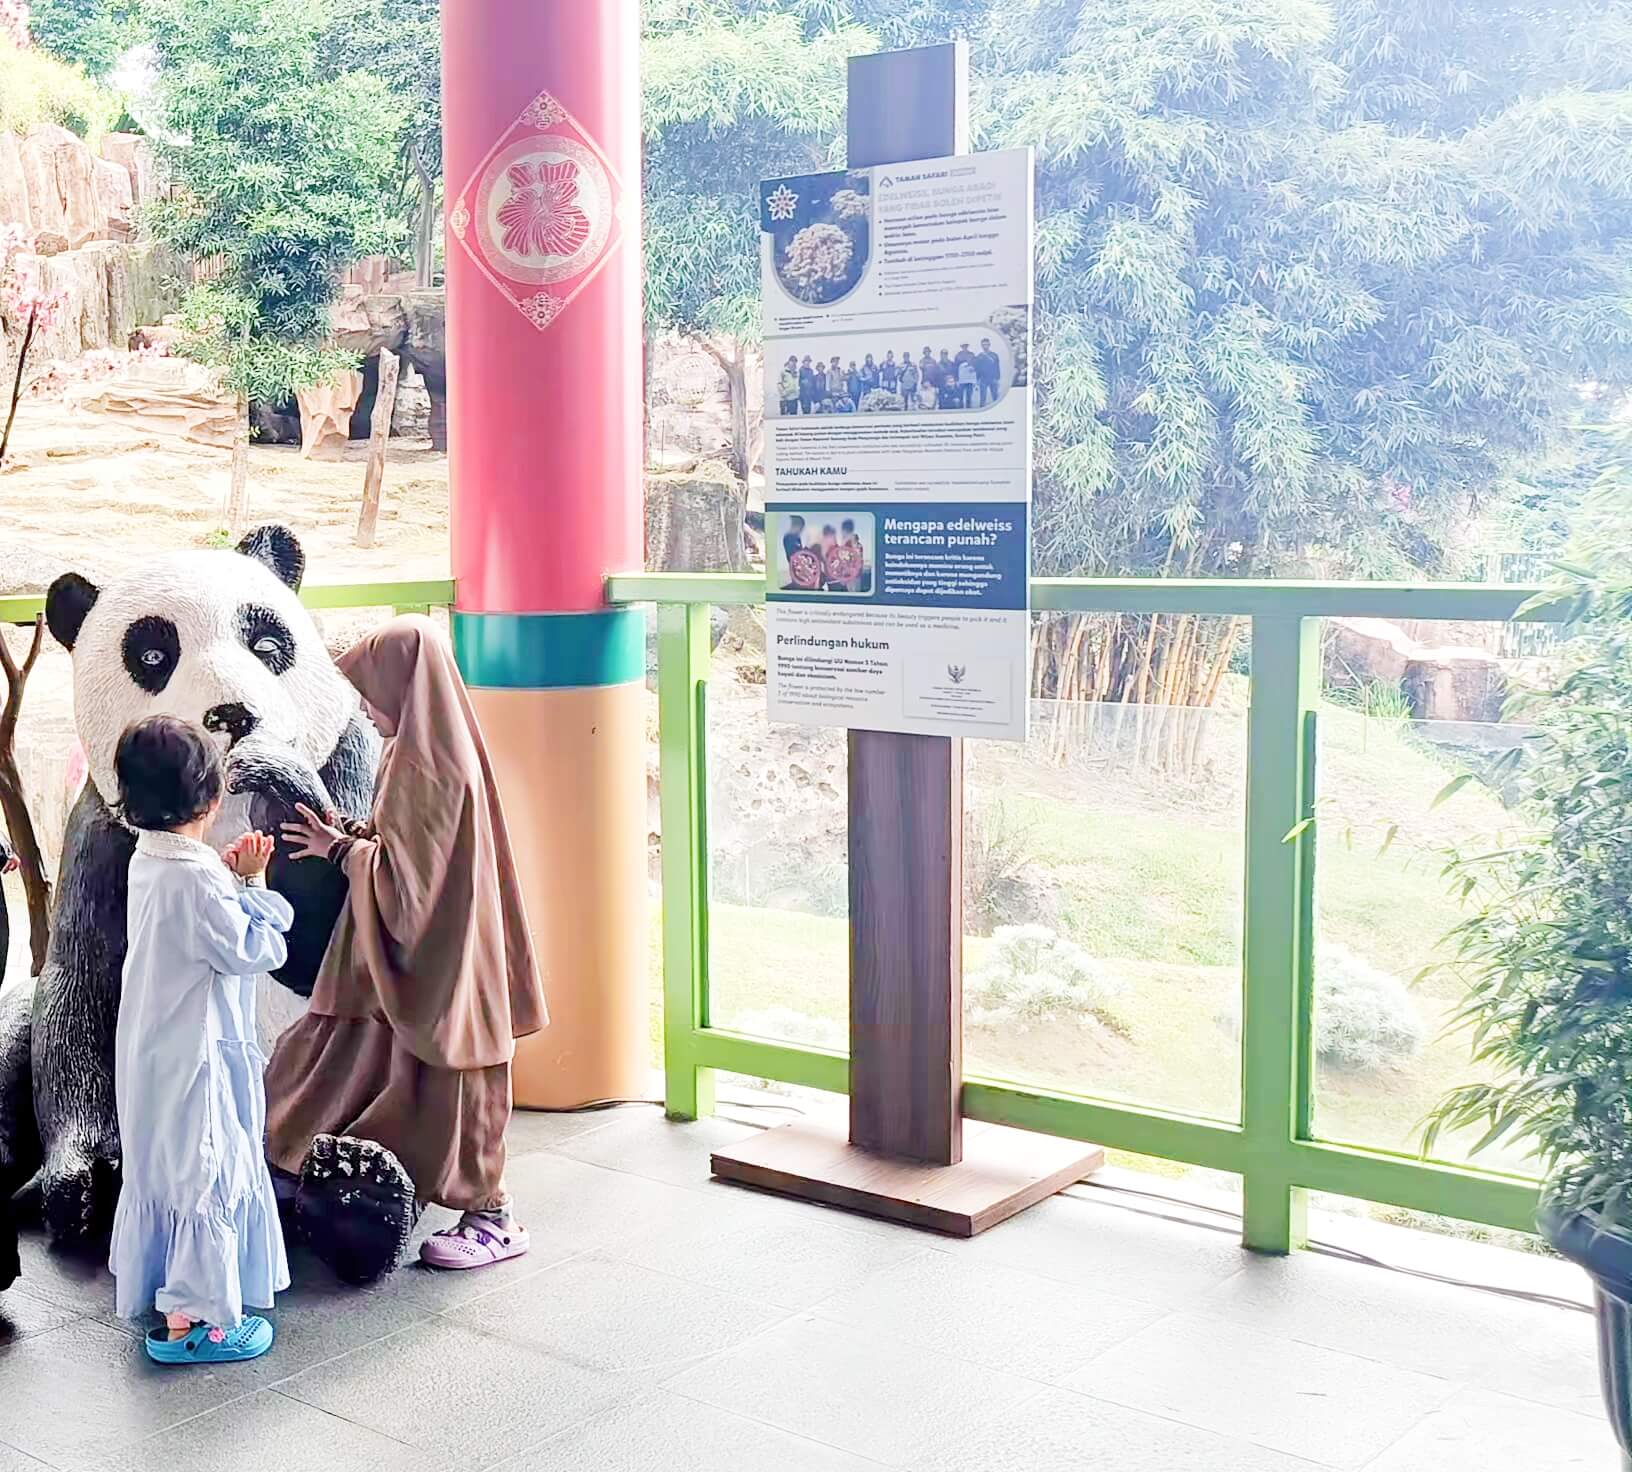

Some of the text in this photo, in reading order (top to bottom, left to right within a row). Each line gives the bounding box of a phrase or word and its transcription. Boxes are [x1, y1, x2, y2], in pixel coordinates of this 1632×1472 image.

[775, 467, 848, 476] TAHUKAH KAMU
[884, 518, 1013, 533] Mengapa edelweiss
[884, 533, 998, 548] terancam punah?
[777, 635, 890, 650] Perlindungan hukum
